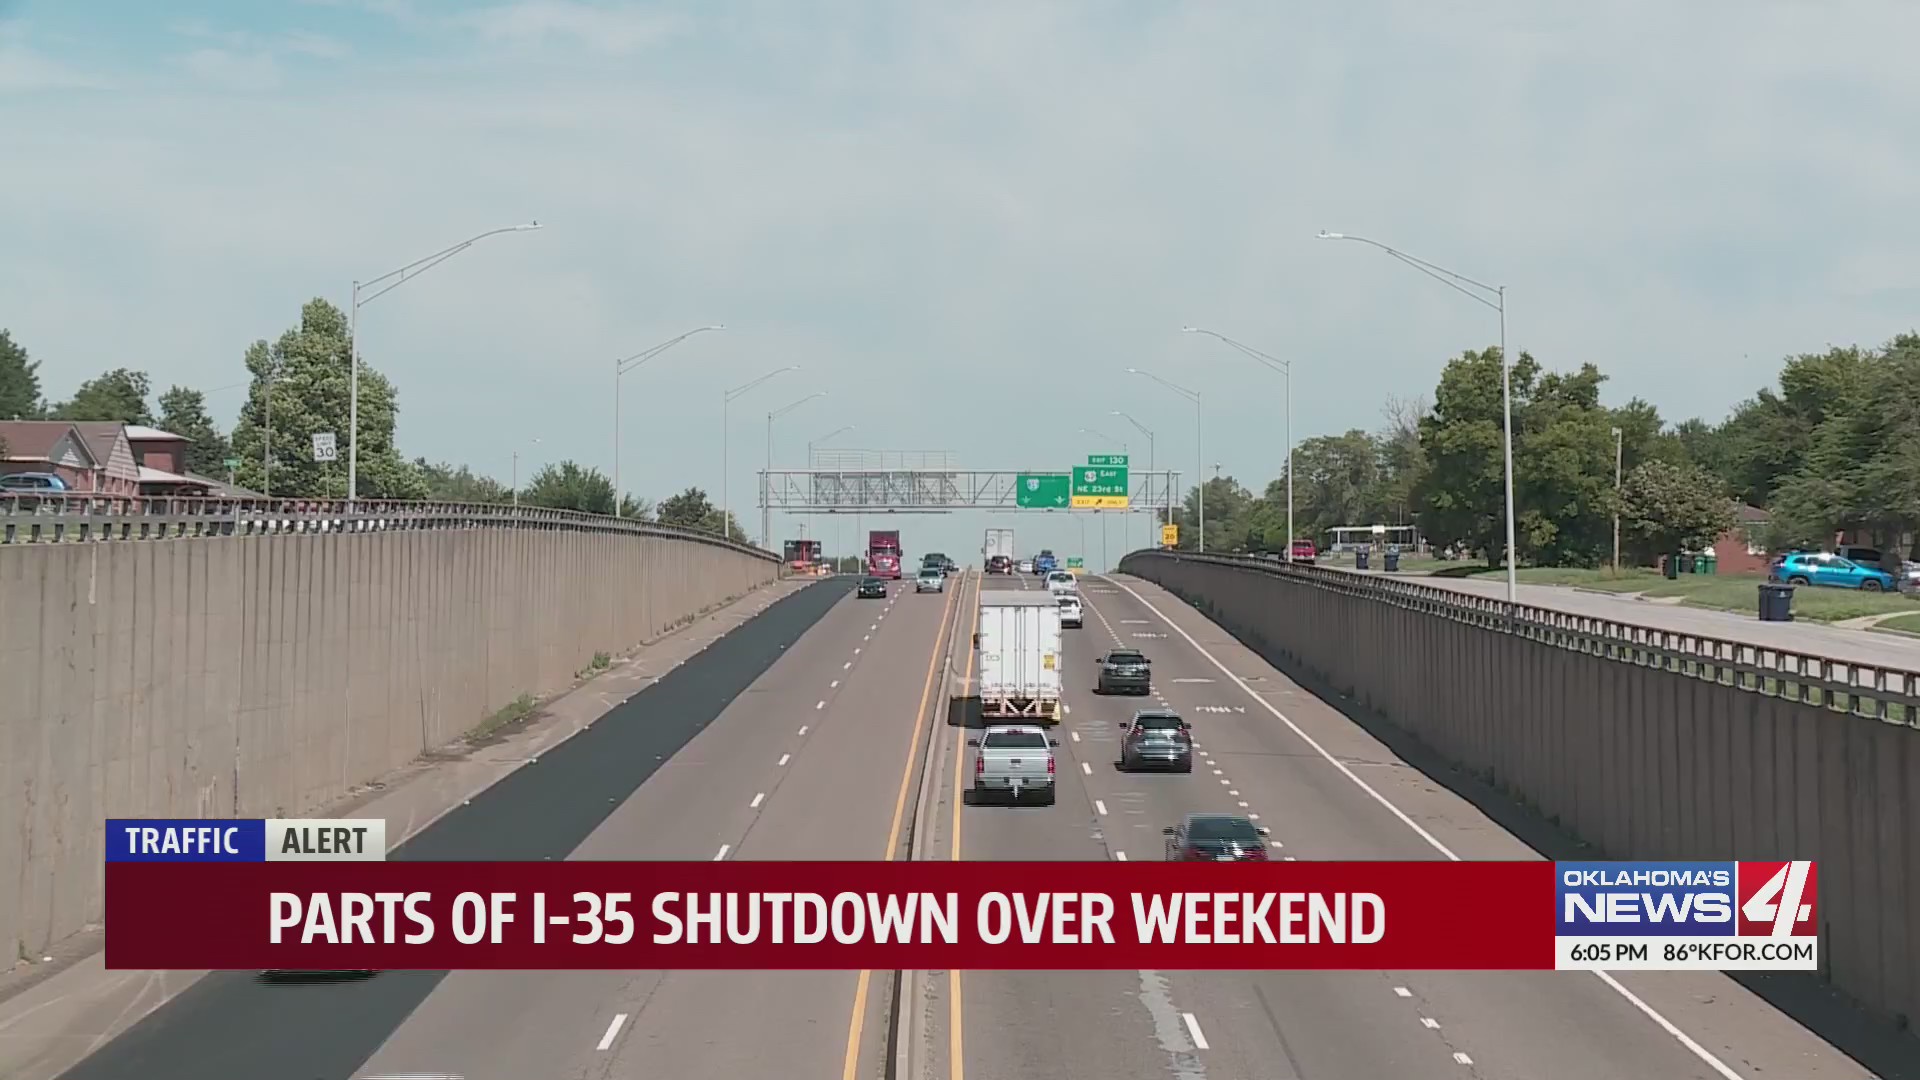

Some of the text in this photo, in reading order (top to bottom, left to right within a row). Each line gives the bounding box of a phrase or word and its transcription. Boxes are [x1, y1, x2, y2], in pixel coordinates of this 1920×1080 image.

[316, 447, 334, 458] 30
[1109, 456, 1125, 465] 130
[1077, 485, 1124, 493] NE 23rd St
